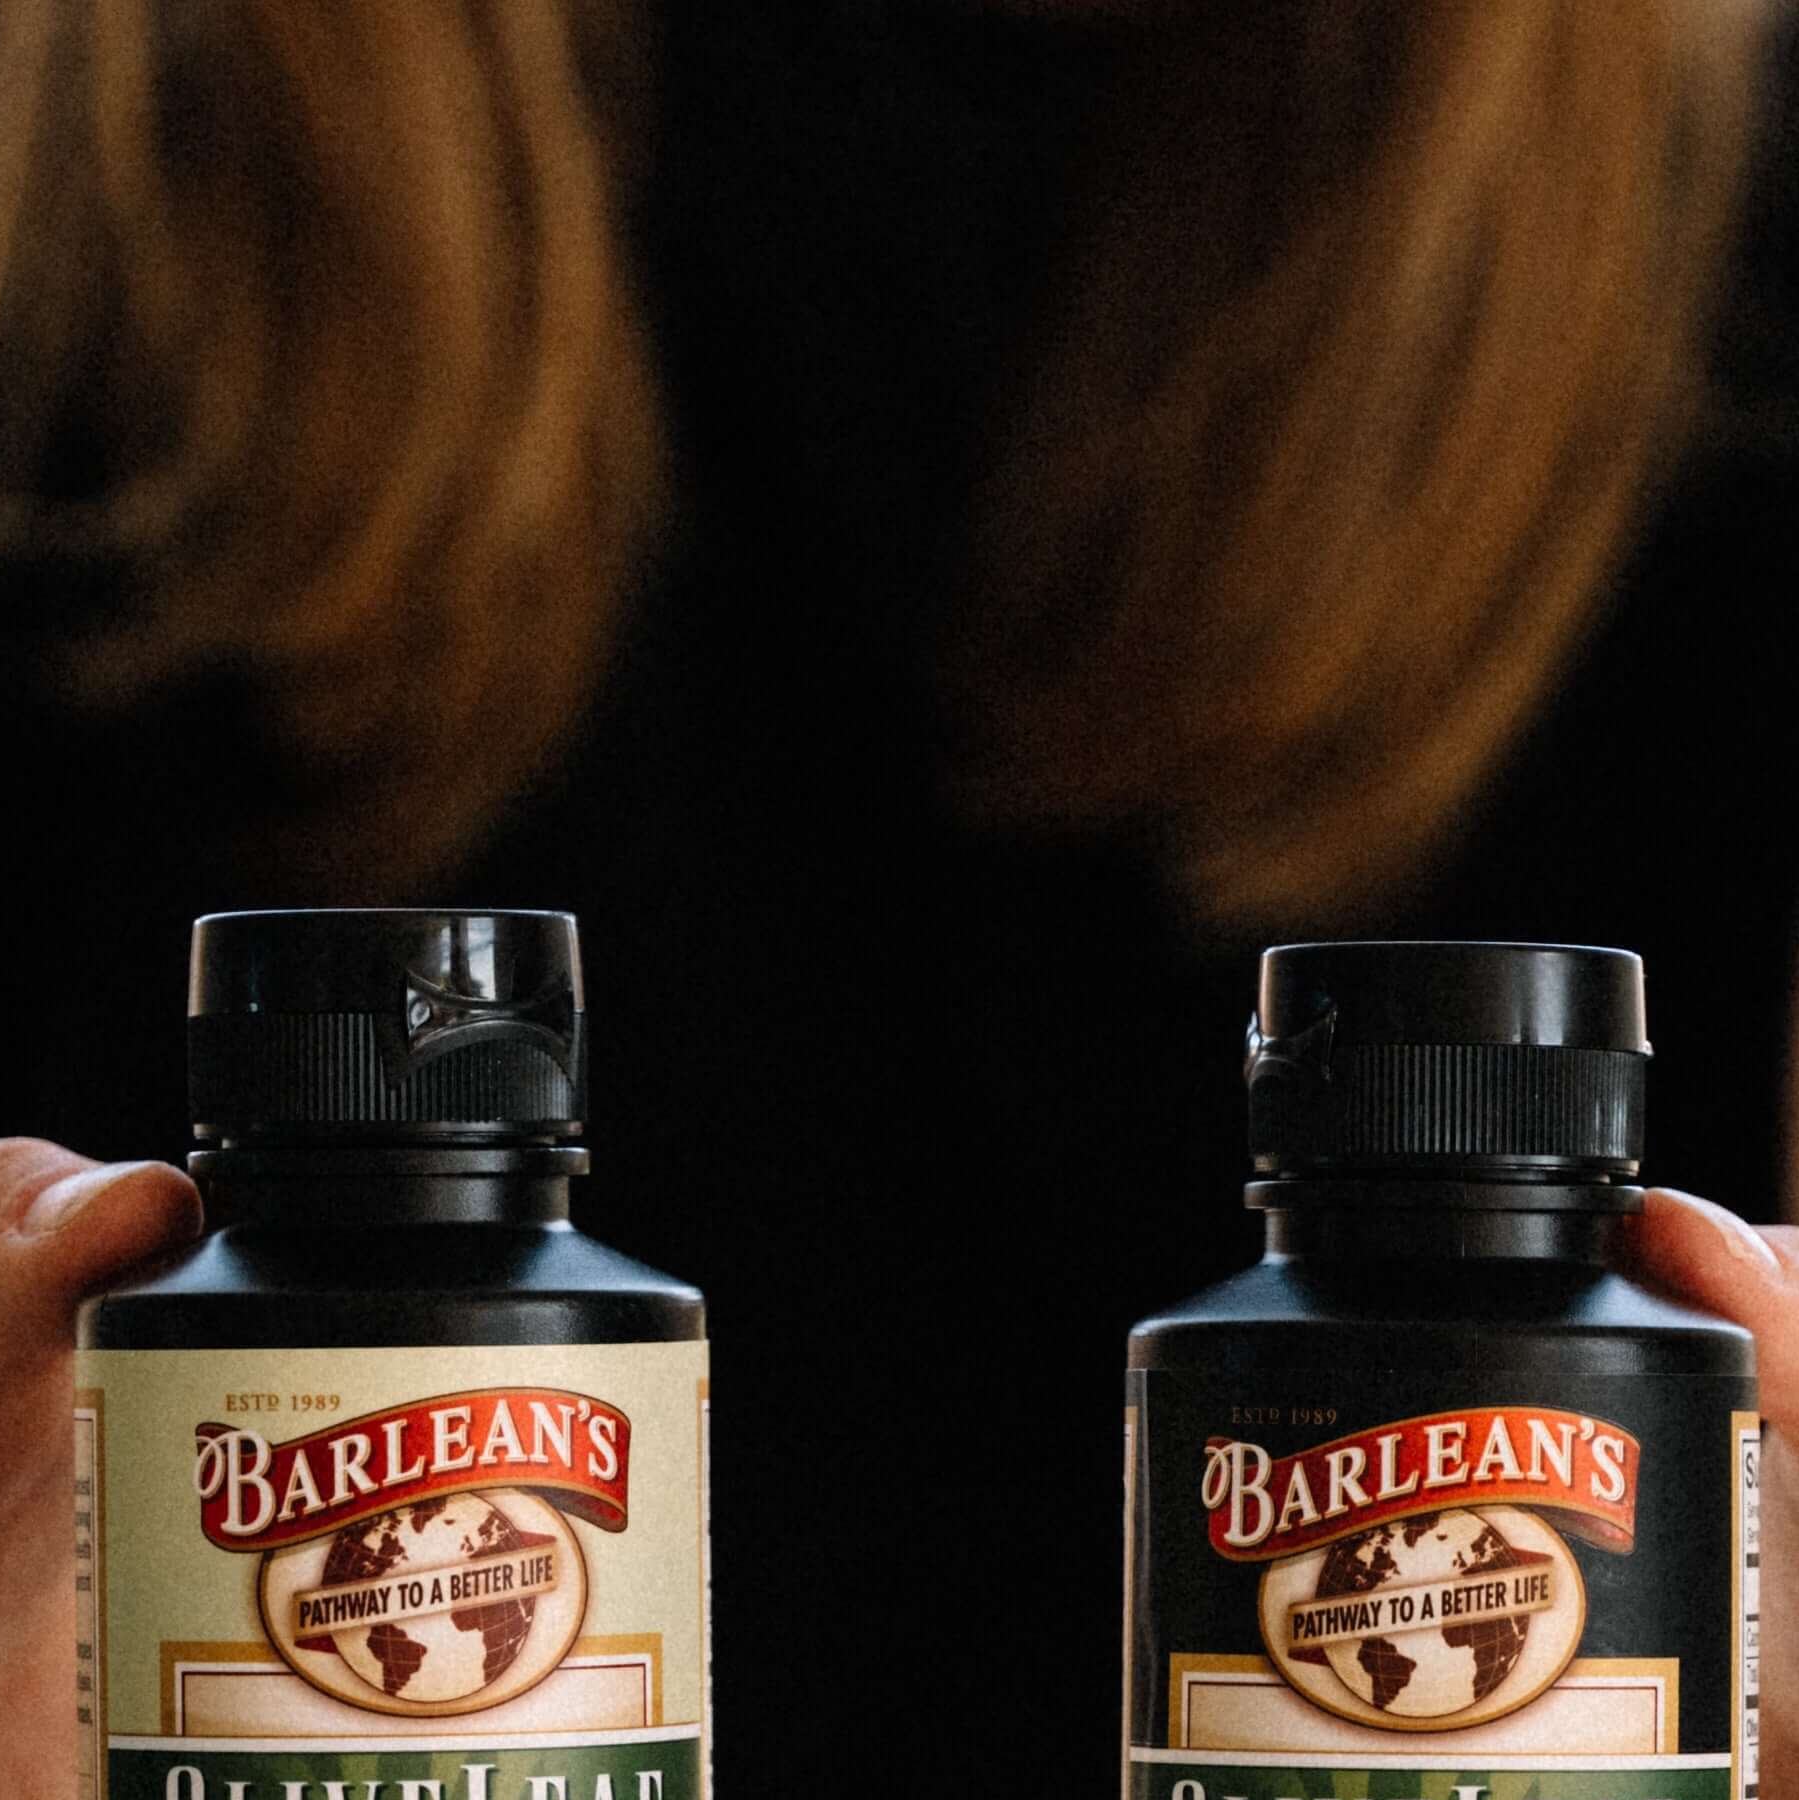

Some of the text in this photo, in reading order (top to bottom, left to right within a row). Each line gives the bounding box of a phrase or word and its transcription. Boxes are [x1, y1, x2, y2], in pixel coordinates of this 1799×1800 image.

[291, 1393, 340, 1412] 1989
[1291, 1406, 1337, 1424] 1989
[193, 1399, 619, 1536] BARLEAN'S
[1202, 1415, 1627, 1548] BARLEAN'S
[299, 1555, 553, 1630] PATHWAY TO A BETTER LIFE
[1292, 1573, 1549, 1641] PATHWAY TO A BETTER LIFE
